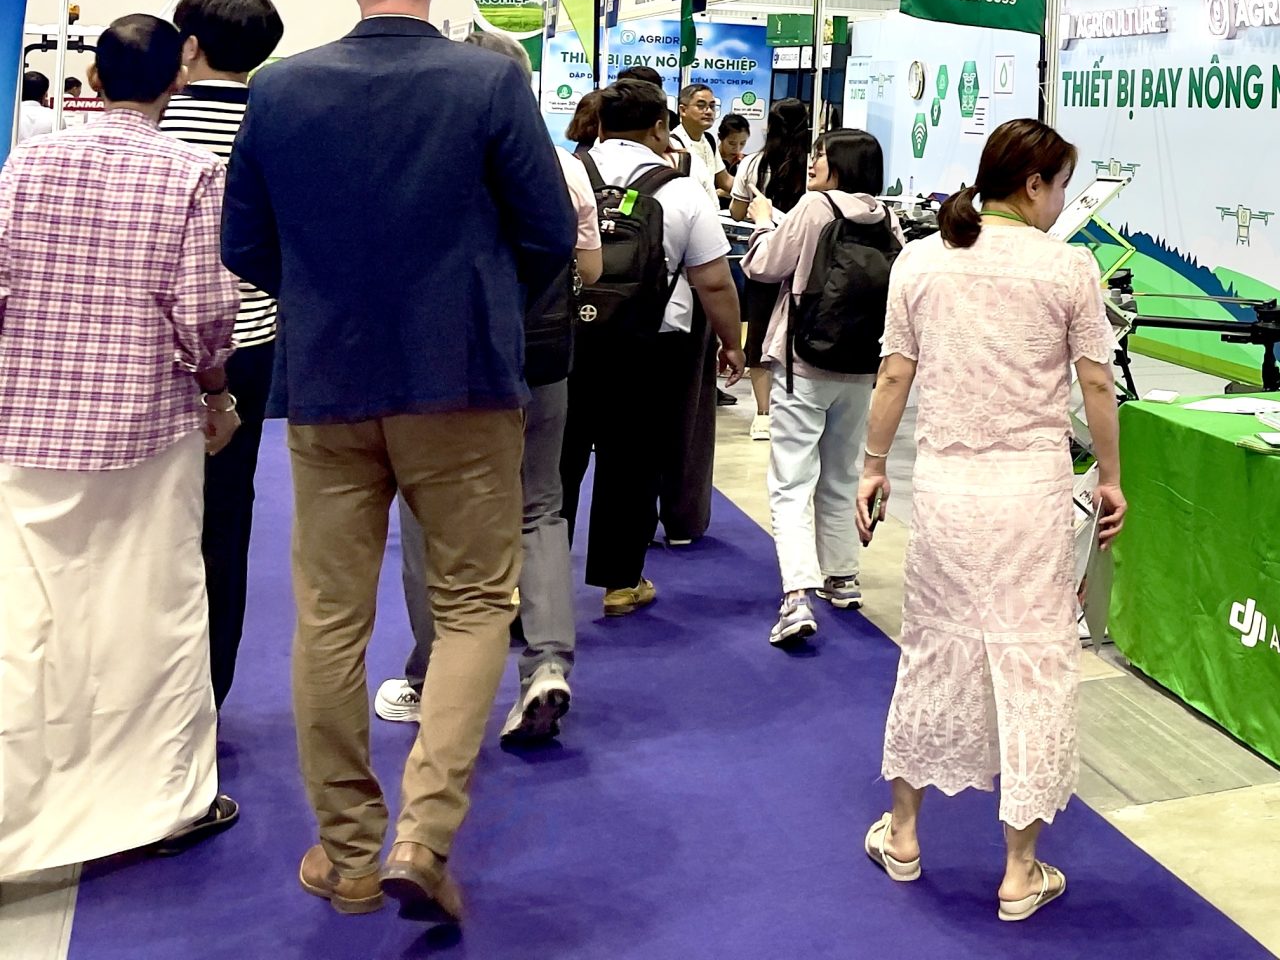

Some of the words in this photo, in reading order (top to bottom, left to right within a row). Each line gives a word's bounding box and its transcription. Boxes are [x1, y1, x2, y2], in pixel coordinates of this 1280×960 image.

[1074, 4, 1169, 39] AGRICULTURE
[638, 34, 703, 47] AGRIDRE
[623, 54, 652, 66] BAY
[655, 51, 700, 68] NÔG
[704, 57, 757, 74] NGHIỆP
[1062, 55, 1113, 108] THIẾT
[1116, 68, 1136, 120] BỊ
[1140, 67, 1183, 108] BAY
[1187, 53, 1264, 110] NÔNG
[62, 100, 105, 108] YANMA
[1228, 597, 1267, 648] dji
